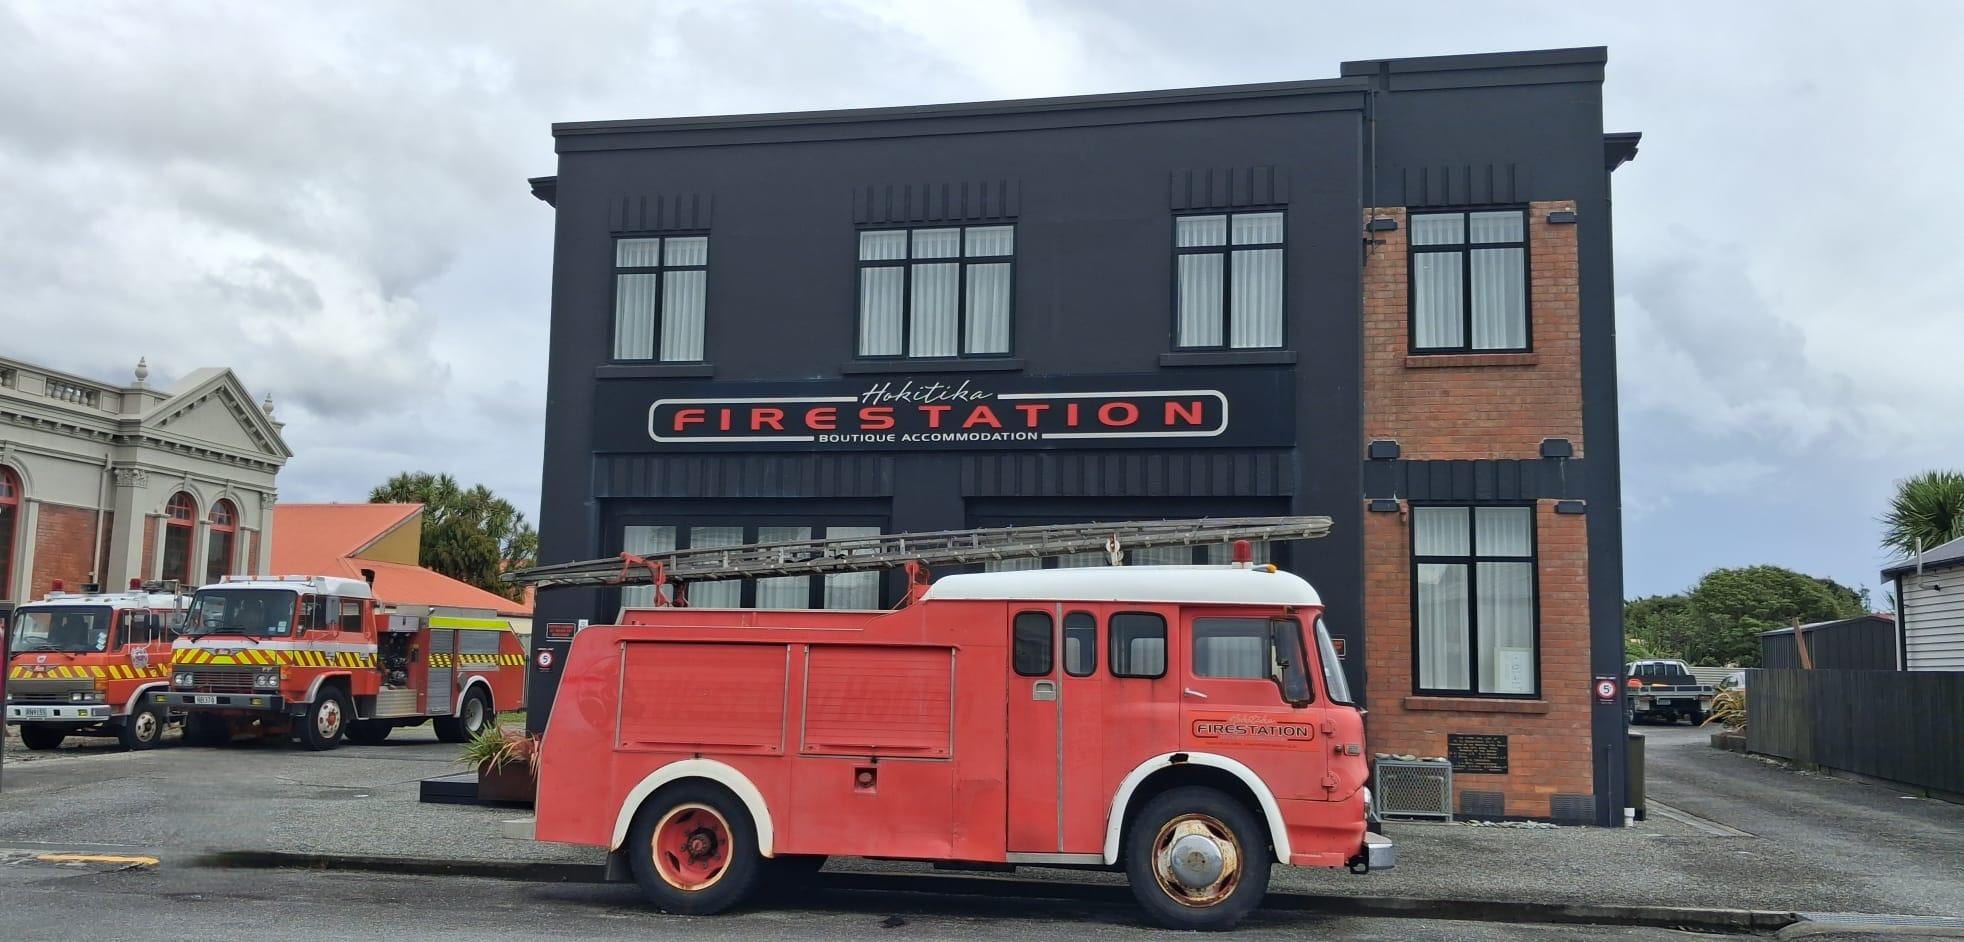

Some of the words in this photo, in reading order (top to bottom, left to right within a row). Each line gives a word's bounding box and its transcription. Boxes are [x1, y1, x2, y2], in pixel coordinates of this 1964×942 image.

[862, 380, 993, 405] Hokitika
[672, 401, 1204, 431] FIRESTATION
[819, 433, 896, 443] BOUTIQUE
[901, 431, 1038, 442] ACCOMMODATION
[1603, 684, 1610, 694] 5
[1197, 724, 1308, 737] FIRESTATION
